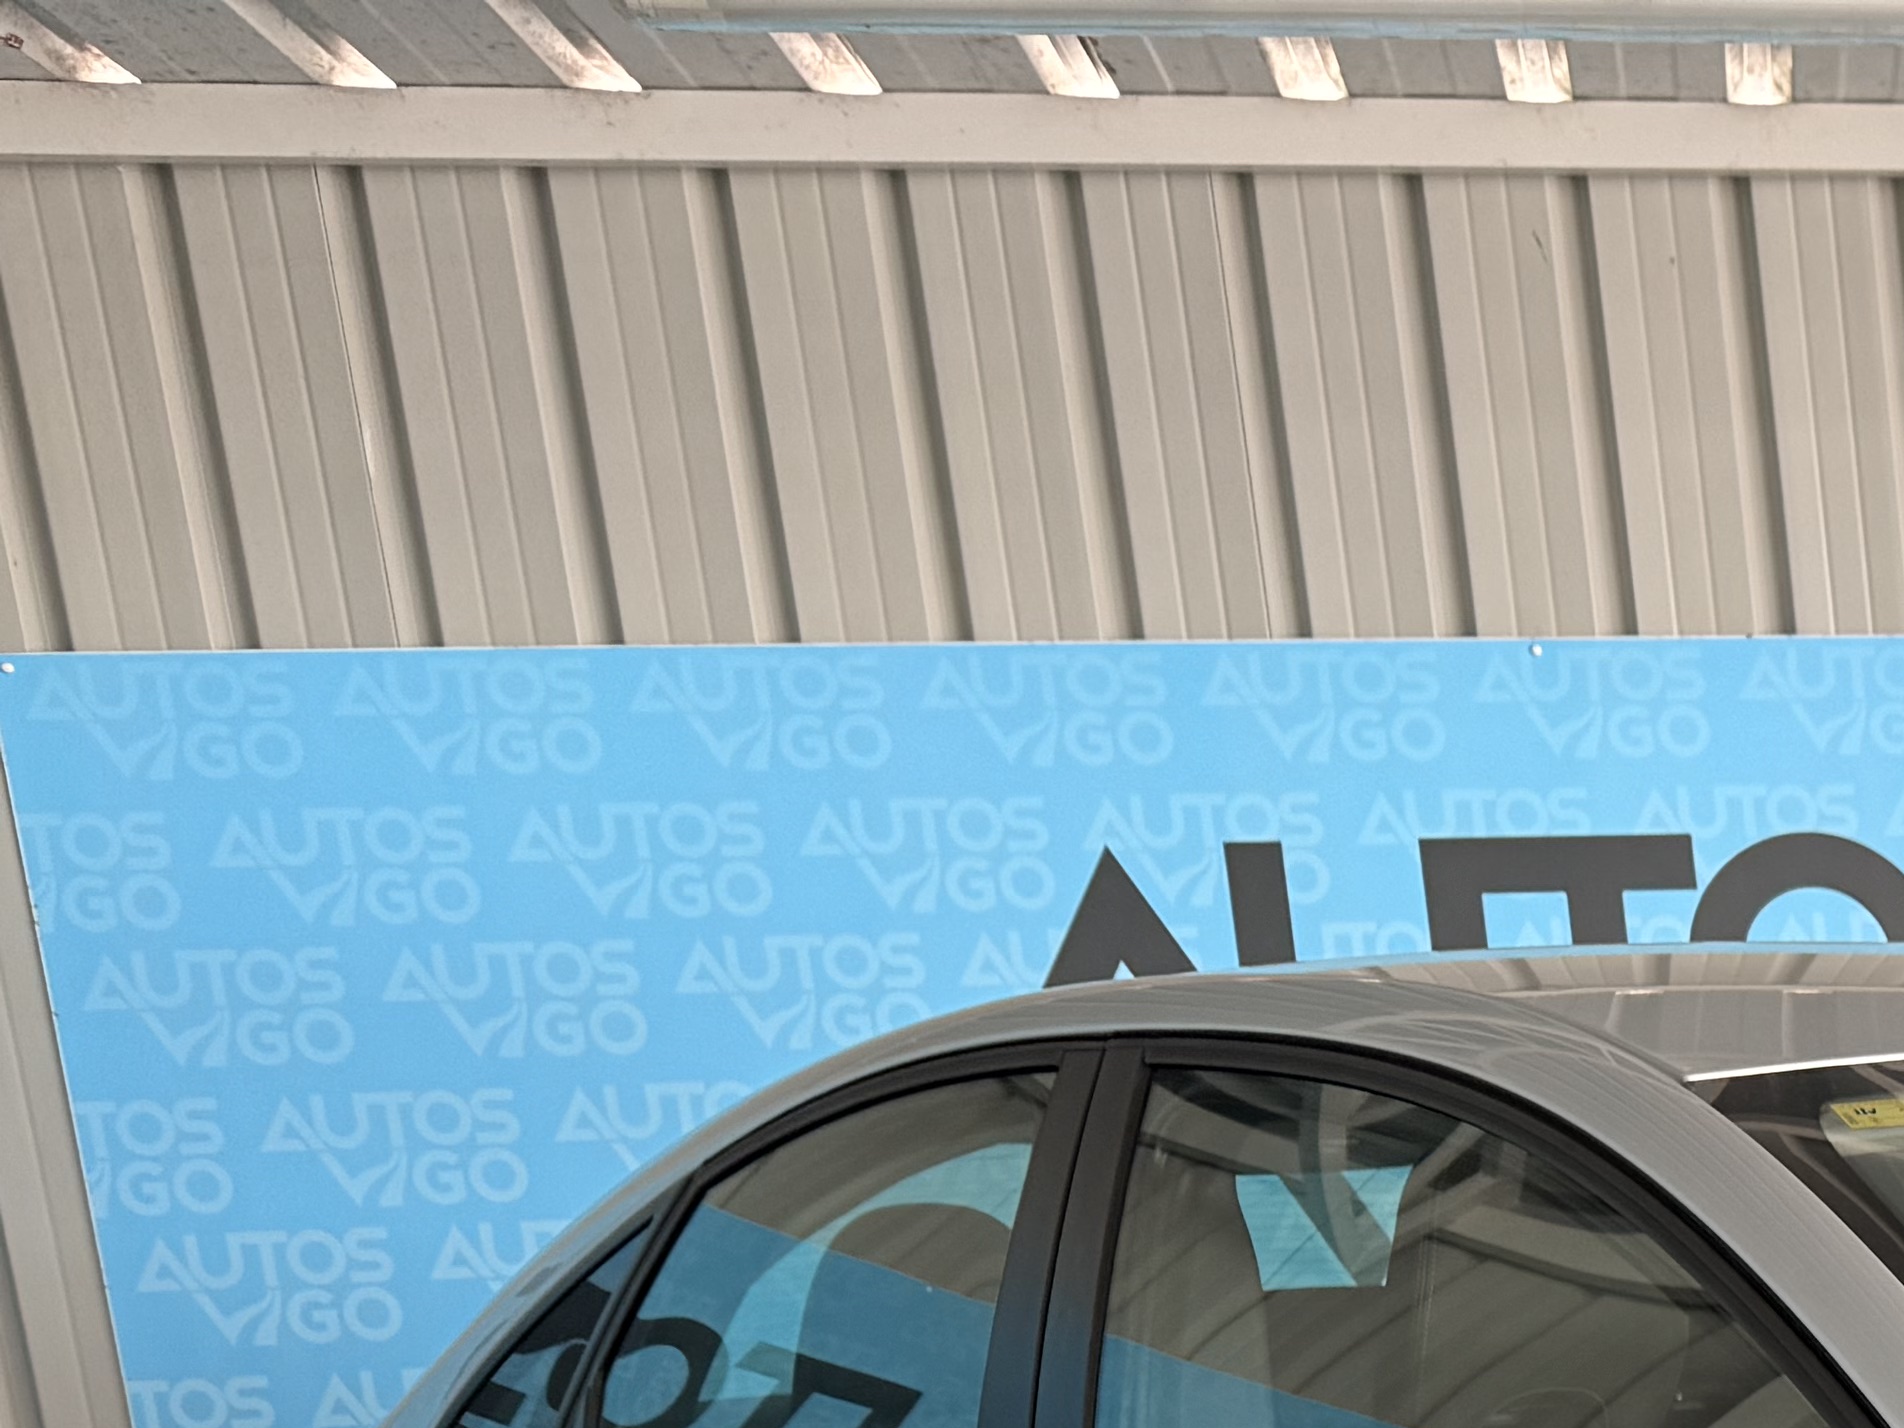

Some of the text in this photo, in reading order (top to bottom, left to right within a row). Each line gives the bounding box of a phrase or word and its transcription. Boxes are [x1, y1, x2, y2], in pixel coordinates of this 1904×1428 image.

[26, 657, 295, 721] AUTOS
[333, 656, 595, 717] AUTOS
[628, 654, 885, 714] AUTOS
[918, 652, 1167, 711] AUTOS
[1203, 650, 1440, 706] AUTOS
[1473, 648, 1705, 703] AUTOS
[85, 720, 303, 780] VIGO
[391, 717, 602, 776] VIGO
[690, 712, 892, 770] VIGO
[974, 709, 1174, 767] VIGO
[1255, 705, 1446, 763] VIGO
[1526, 703, 1711, 759] VIGO
[209, 806, 473, 868] AUTOS
[507, 801, 765, 863] AUTOS
[800, 796, 1050, 855] AUTOS
[267, 866, 482, 928] VIGO
[566, 862, 774, 920] VIGO
[857, 855, 1056, 914] VIGO
[82, 945, 346, 1011] AUTOS
[381, 938, 641, 1002] AUTOS
[674, 931, 927, 994] AUTOS
[139, 1006, 356, 1069] VIGO
[437, 998, 649, 1059] VIGO
[261, 1088, 521, 1153] AUTOS
[320, 1147, 530, 1208] VIGO
[136, 1226, 395, 1292] AUTOS
[191, 1287, 403, 1347] VIGO
